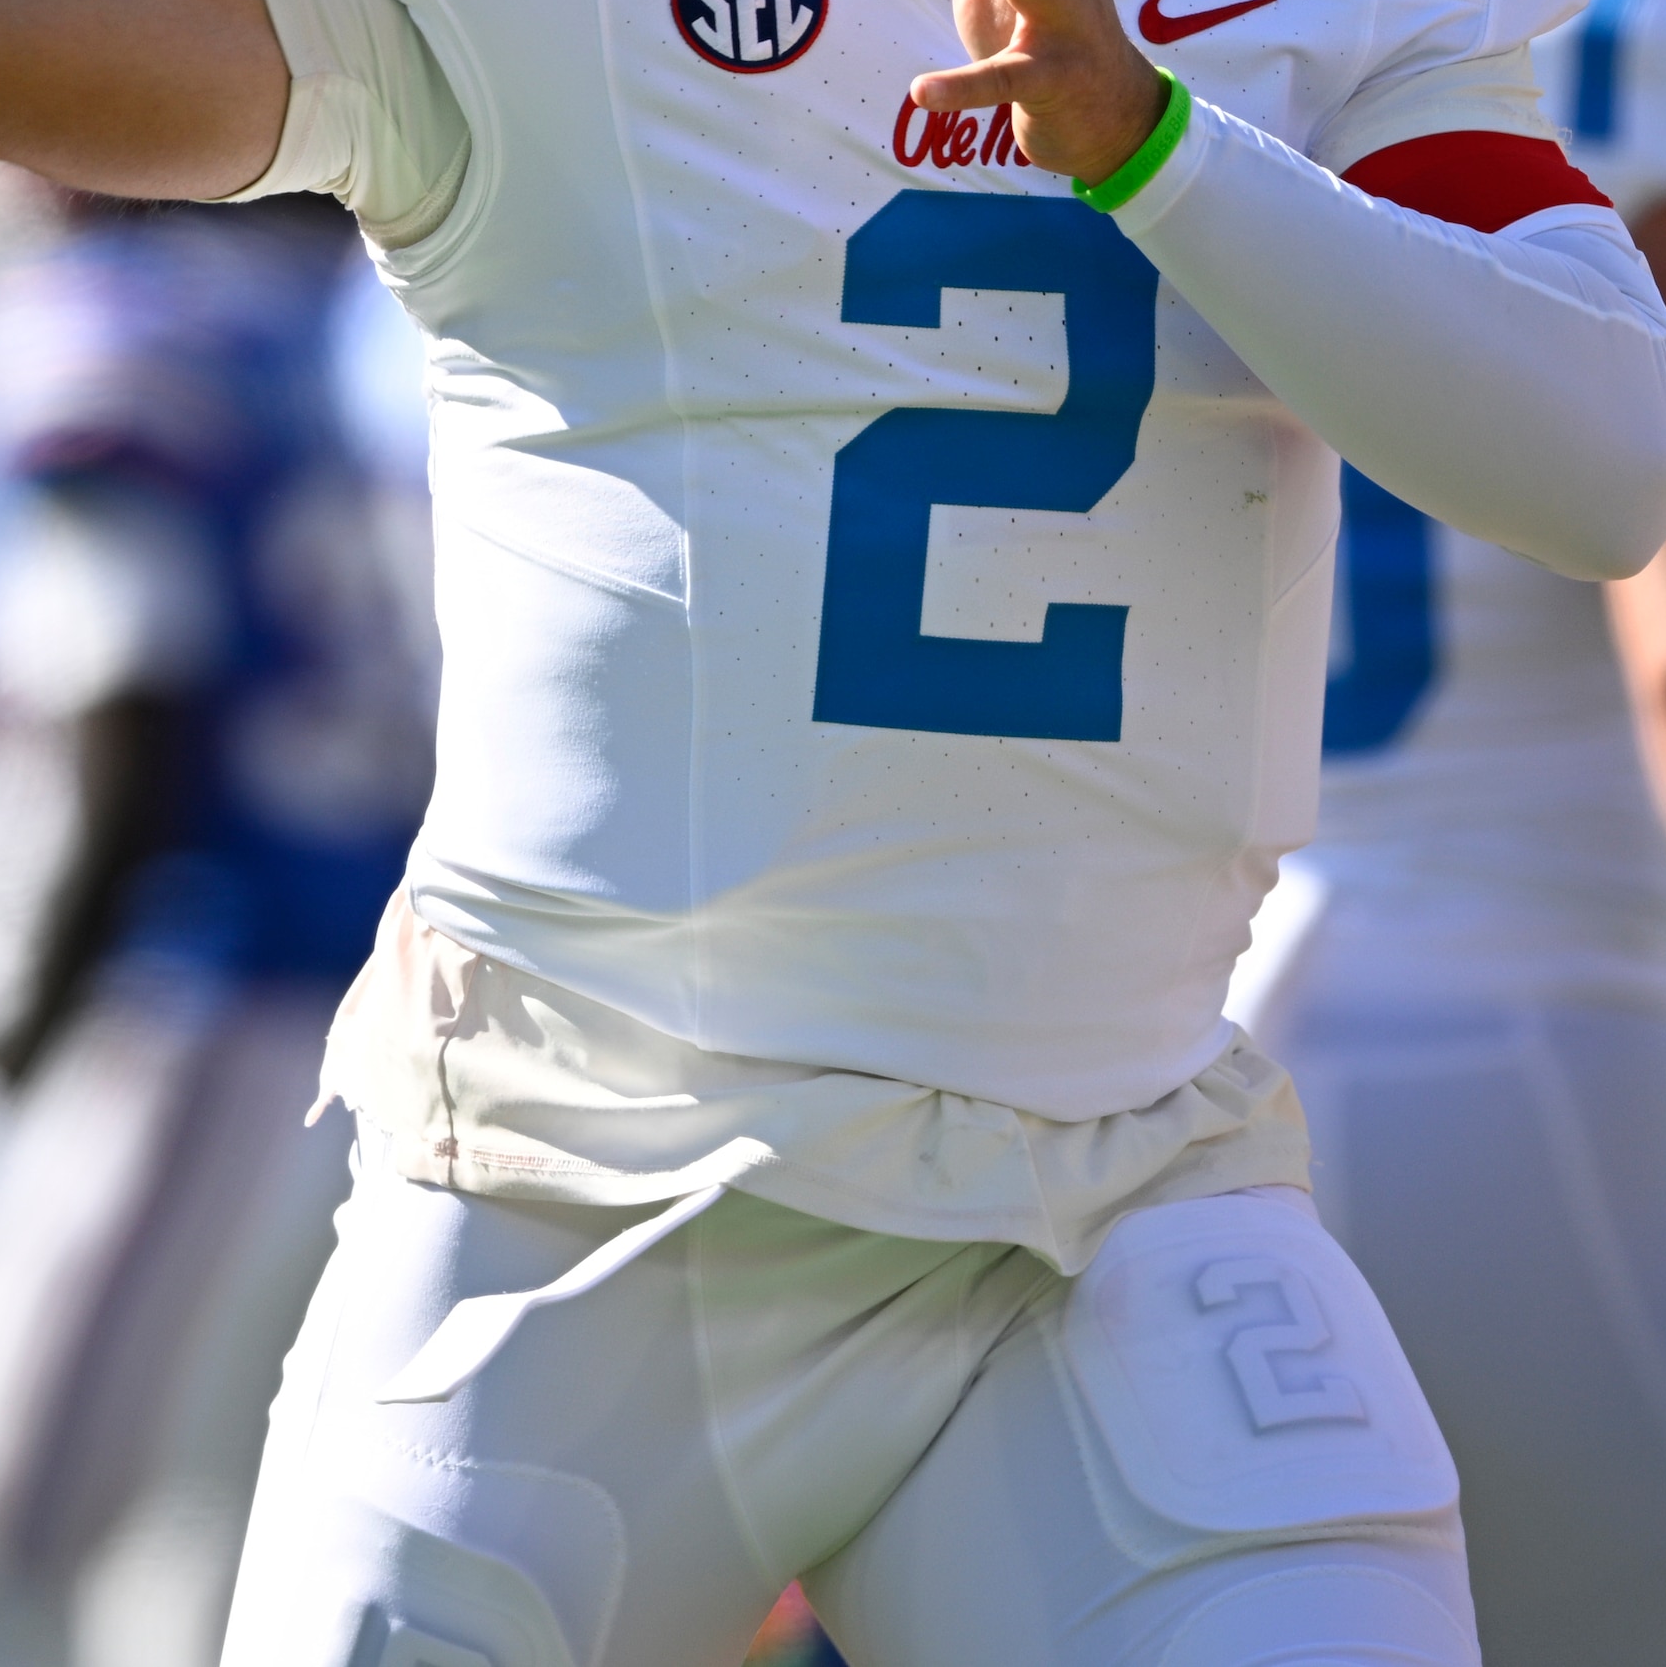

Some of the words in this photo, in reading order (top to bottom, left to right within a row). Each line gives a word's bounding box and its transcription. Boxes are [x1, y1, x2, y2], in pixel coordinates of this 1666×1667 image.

[893, 90, 979, 169] Ole
[1137, 132, 1174, 173] Ross
[812, 188, 1160, 743] 2
[1192, 1257, 1369, 1434] 2
